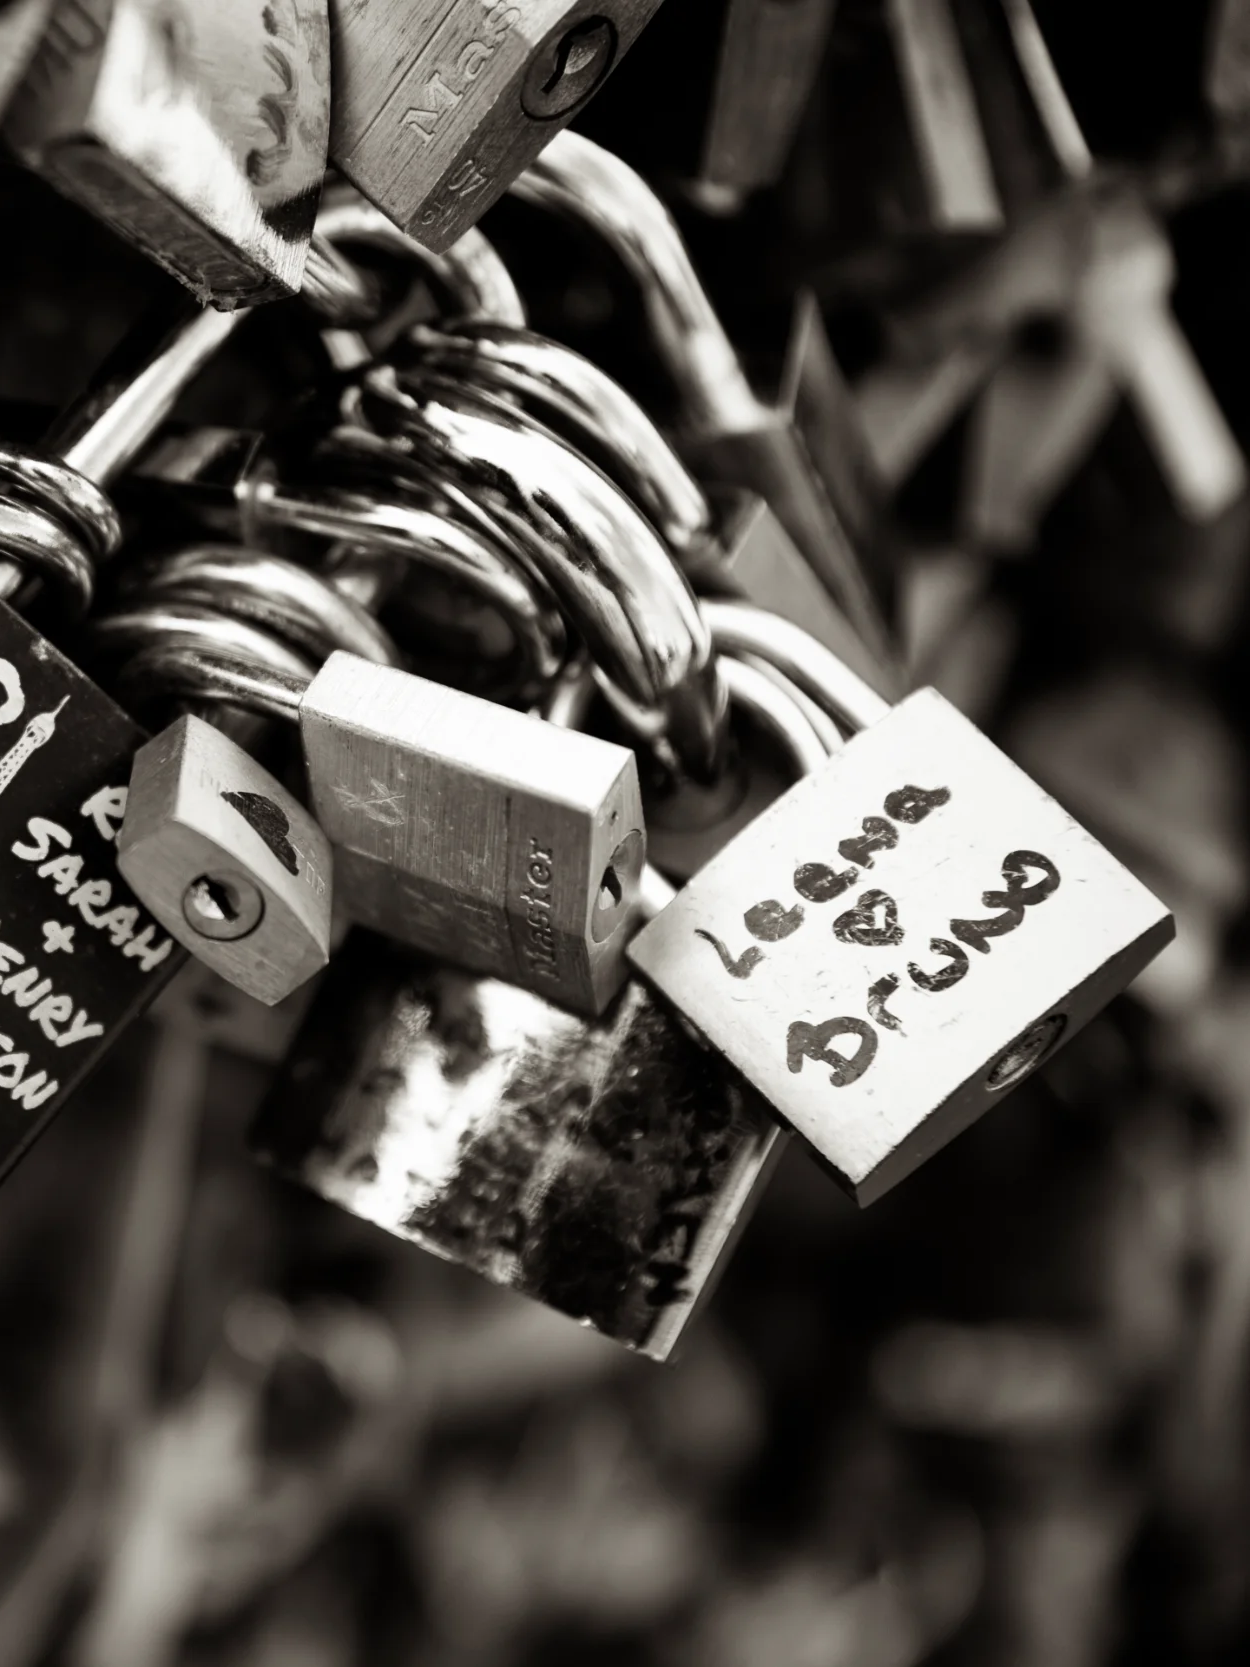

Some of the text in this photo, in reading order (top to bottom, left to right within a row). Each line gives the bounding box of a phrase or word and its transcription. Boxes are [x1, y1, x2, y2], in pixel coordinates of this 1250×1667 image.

[11, 817, 173, 972] SARAH
[81, 785, 129, 846] R
[695, 784, 952, 979] Leena
[786, 850, 1062, 1088] Bruno
